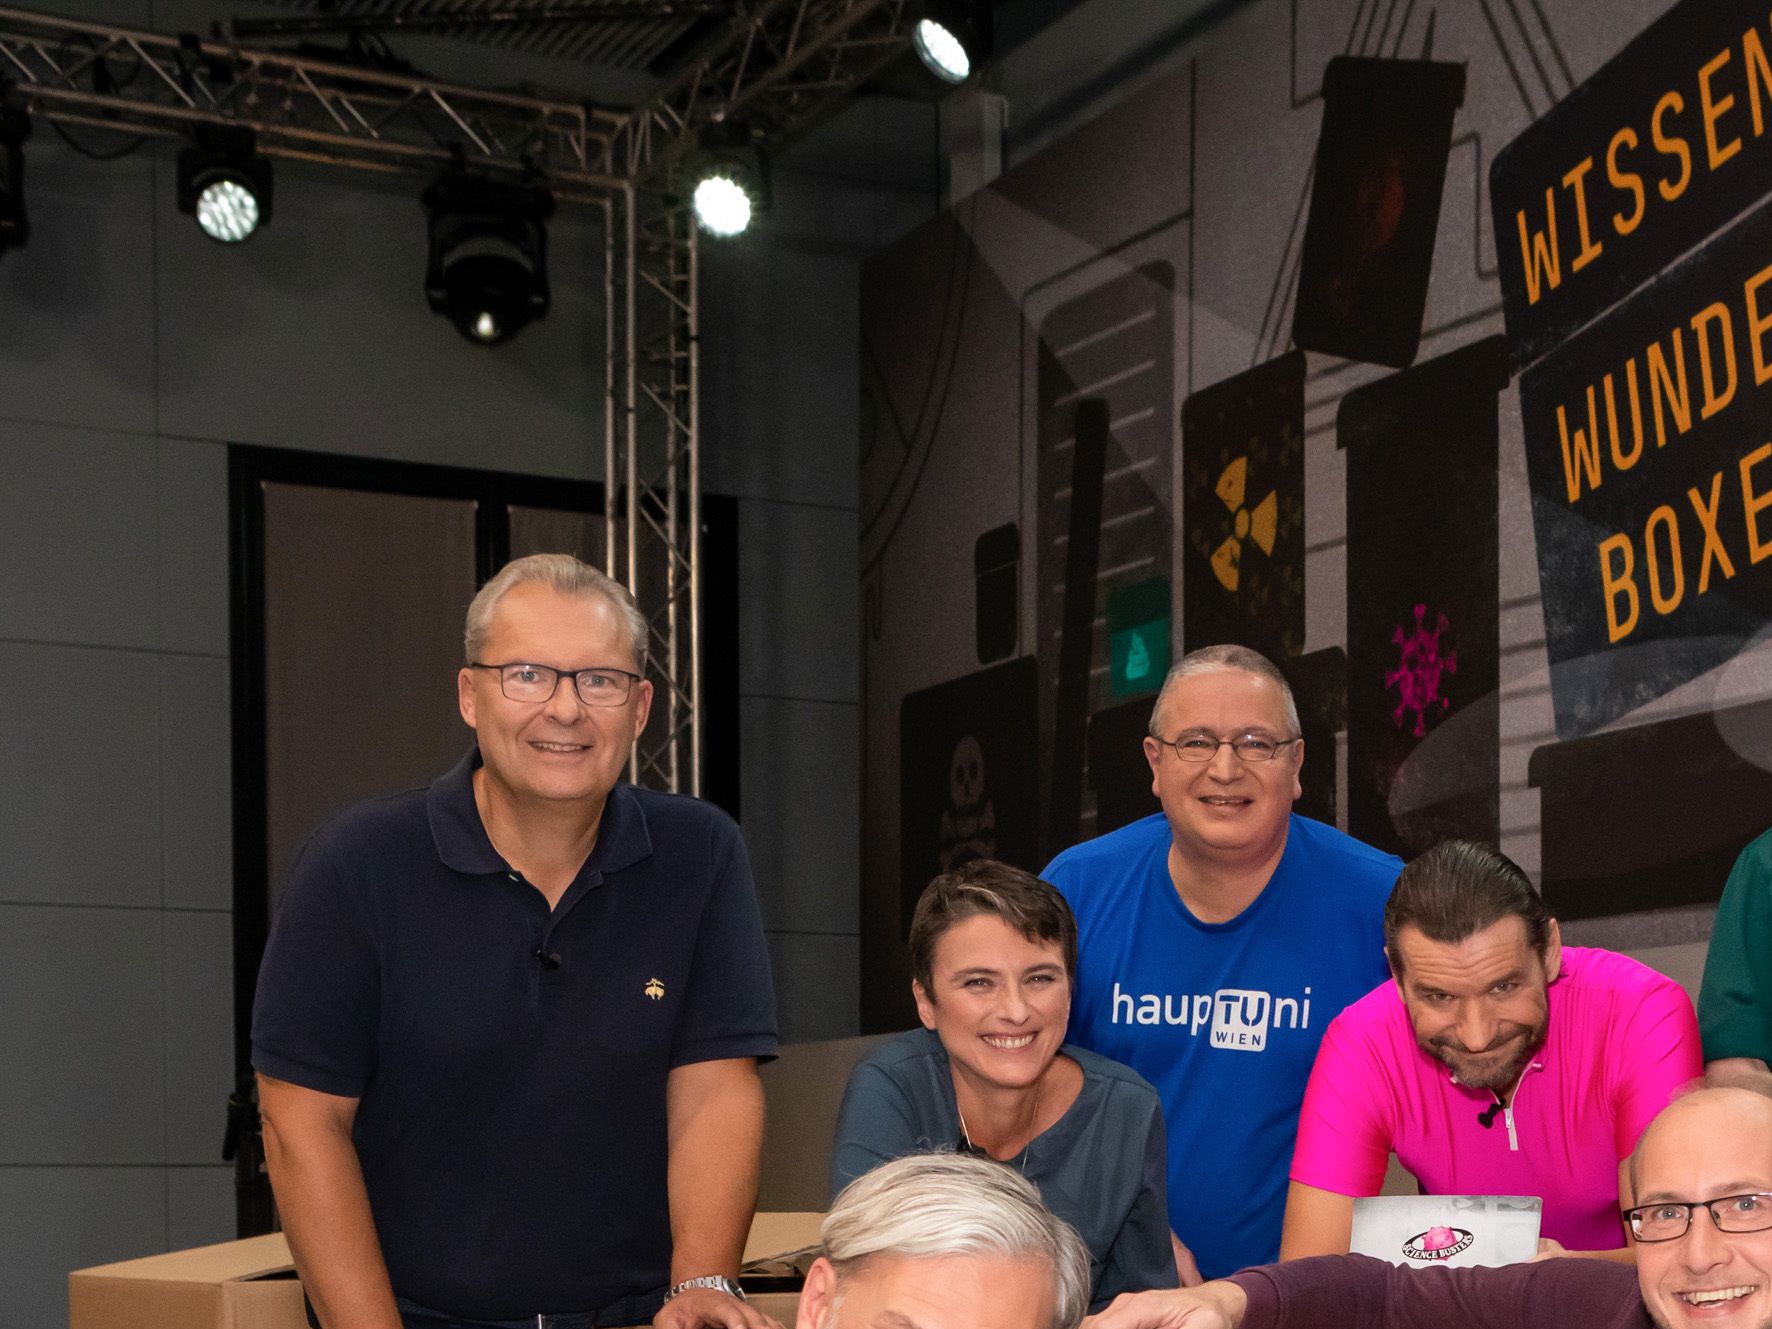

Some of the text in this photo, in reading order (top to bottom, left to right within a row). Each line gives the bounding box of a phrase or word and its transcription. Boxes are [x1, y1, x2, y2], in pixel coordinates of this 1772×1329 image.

[1215, 1031, 1261, 1046] WIEN
[1402, 1234, 1474, 1259] SCIENCE BUSTERS
